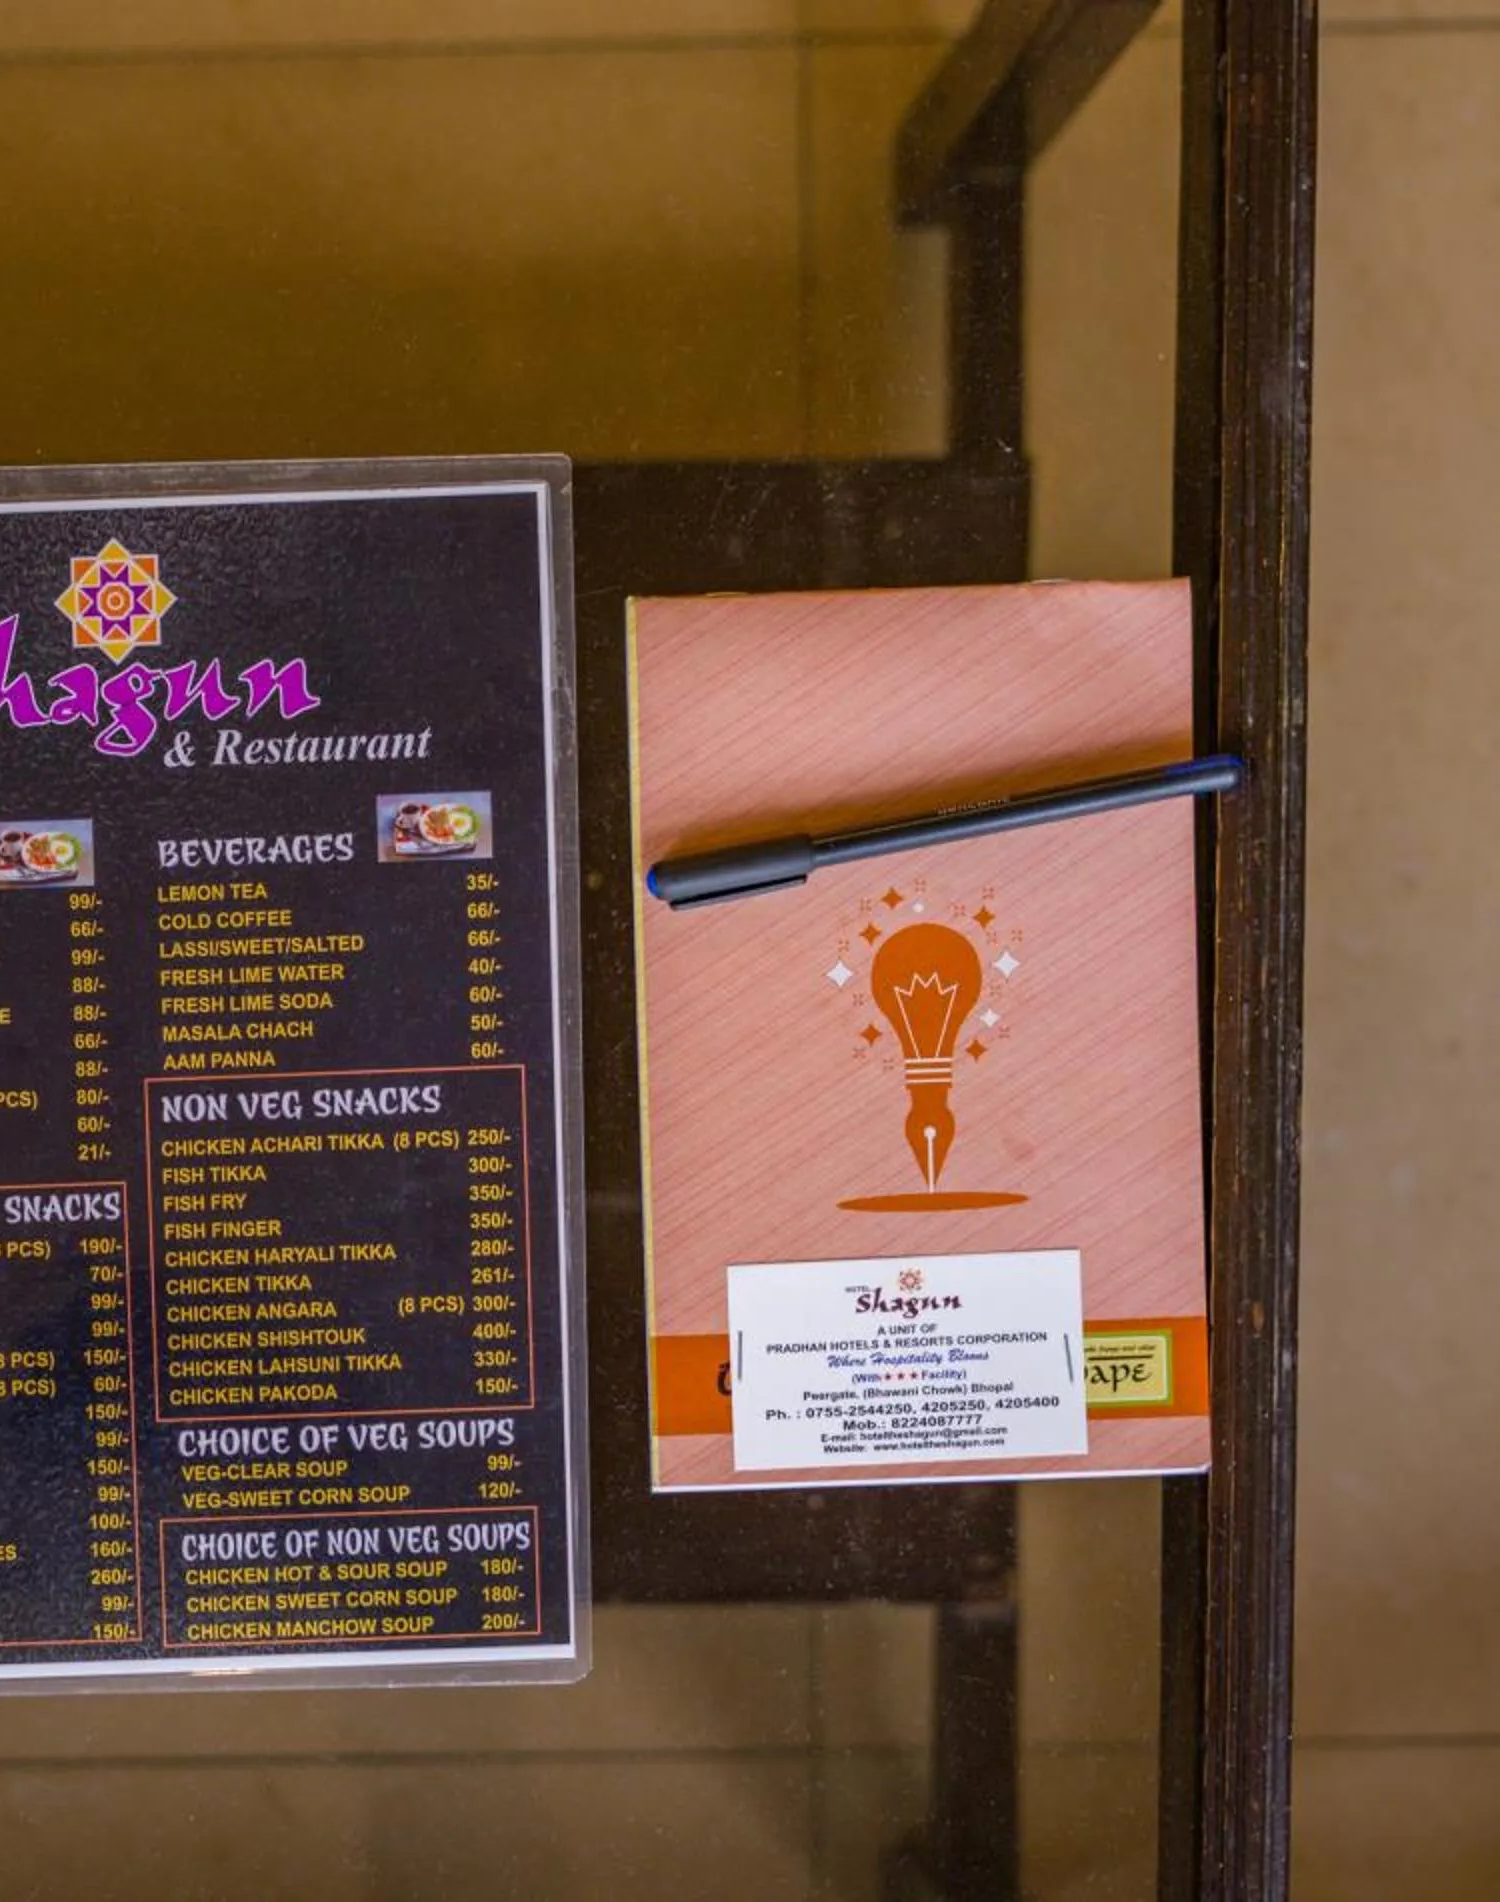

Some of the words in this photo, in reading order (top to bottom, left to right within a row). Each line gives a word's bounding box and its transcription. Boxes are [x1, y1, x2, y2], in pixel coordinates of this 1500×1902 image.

[163, 730, 196, 768] &
[211, 724, 433, 766] Restaurant
[157, 831, 354, 868] BEVERAGES
[157, 884, 225, 903] LEMON
[229, 882, 268, 900] TEA
[466, 872, 500, 891] 35/-
[68, 892, 103, 910] 99/-
[159, 934, 364, 959] LASSI/SWEET/SALTED
[466, 929, 502, 947] 66/-
[70, 948, 105, 966] 99/-
[159, 967, 223, 986] FRESH
[228, 965, 273, 984] LIME
[277, 962, 345, 982] WATER
[467, 957, 502, 975] 40/-
[71, 975, 106, 993] 88/-
[73, 1004, 108, 1021] 88/-
[162, 1023, 242, 1042] MASALA
[245, 1020, 314, 1040] CHACH
[470, 1013, 504, 1031] 50/-
[75, 1087, 110, 1105] 80/-
[161, 1093, 228, 1123] NON
[236, 1090, 303, 1120] VEG
[312, 1084, 441, 1118] SNACKS
[77, 1142, 112, 1161] 21/-
[161, 1137, 246, 1157] CHICKEN
[250, 1135, 323, 1153] ACHARI
[326, 1132, 385, 1151] TIKKA
[414, 1129, 460, 1150] PCS)
[467, 1128, 512, 1146] 250/-
[3, 1191, 122, 1224] SNACKS
[162, 1194, 206, 1212] FISH
[209, 1192, 247, 1210] FRY
[468, 1183, 514, 1202] 350/-
[4, 1239, 51, 1260] PCS)
[79, 1236, 124, 1254] 190/-
[164, 1247, 249, 1267] CHICKEN
[253, 1246, 334, 1265] HARYALI
[338, 1243, 397, 1261] TIKKA
[470, 1238, 515, 1257] 280/-
[90, 1292, 125, 1310] 99/-
[855, 1286, 962, 1319] Shagun
[167, 1331, 252, 1351] CHICKEN
[256, 1327, 366, 1348] SHISHTOUK
[471, 1321, 517, 1340] 400/-
[877, 1325, 886, 1336] A
[889, 1324, 917, 1336] UNIT
[920, 1323, 938, 1334] OF
[766, 1342, 827, 1355] PRADHAN
[830, 1339, 879, 1351] HOTELS
[883, 1338, 891, 1349] &
[895, 1335, 954, 1349] RESORTS
[957, 1331, 1048, 1345] CORPORATION
[9, 1350, 55, 1371] PCS)
[83, 1346, 128, 1365] 150/-
[826, 1354, 867, 1369] Where
[869, 1351, 943, 1366] Hospitality
[948, 1347, 990, 1362] Blooms
[852, 1373, 882, 1384] (With
[921, 1369, 967, 1381] Facility)
[863, 1386, 919, 1400] (Bhawani
[921, 1383, 968, 1396] Chowk)
[971, 1381, 1014, 1394] Bhopal
[995, 1395, 1059, 1409] 4205400
[85, 1402, 129, 1420] 150/-
[891, 1414, 982, 1430] 8224087777
[177, 1425, 291, 1457] CHOICE
[299, 1423, 339, 1453] OF
[346, 1421, 408, 1451] VEG
[416, 1417, 515, 1449] SOUPS
[181, 1461, 291, 1482] VEG-CLEAR
[295, 1459, 349, 1478] SOUP
[486, 1453, 521, 1471] 99/-
[182, 1488, 293, 1510] VEG-SWEET
[298, 1487, 354, 1505] CORN
[357, 1484, 411, 1504] SOUP
[478, 1481, 522, 1499] 120/-
[89, 1512, 133, 1530] 100/-
[90, 1538, 133, 1557] 160/-
[181, 1530, 277, 1562] CHOICE
[284, 1528, 319, 1558] OF
[326, 1527, 380, 1556] NON
[387, 1524, 440, 1554] VEG
[447, 1520, 532, 1552] SOUPS
[184, 1566, 270, 1585] CHICKEN
[273, 1564, 313, 1583] HOT
[336, 1562, 390, 1581] SOUR
[395, 1559, 448, 1578] SOUP
[480, 1557, 524, 1575] 180/-
[101, 1594, 135, 1612] 99/-
[93, 1622, 137, 1641] 150/-
[187, 1621, 272, 1641] CHICKEN
[275, 1618, 377, 1637] MANCHOW
[381, 1615, 434, 1633] SOUP
[482, 1612, 526, 1631] 200/-
